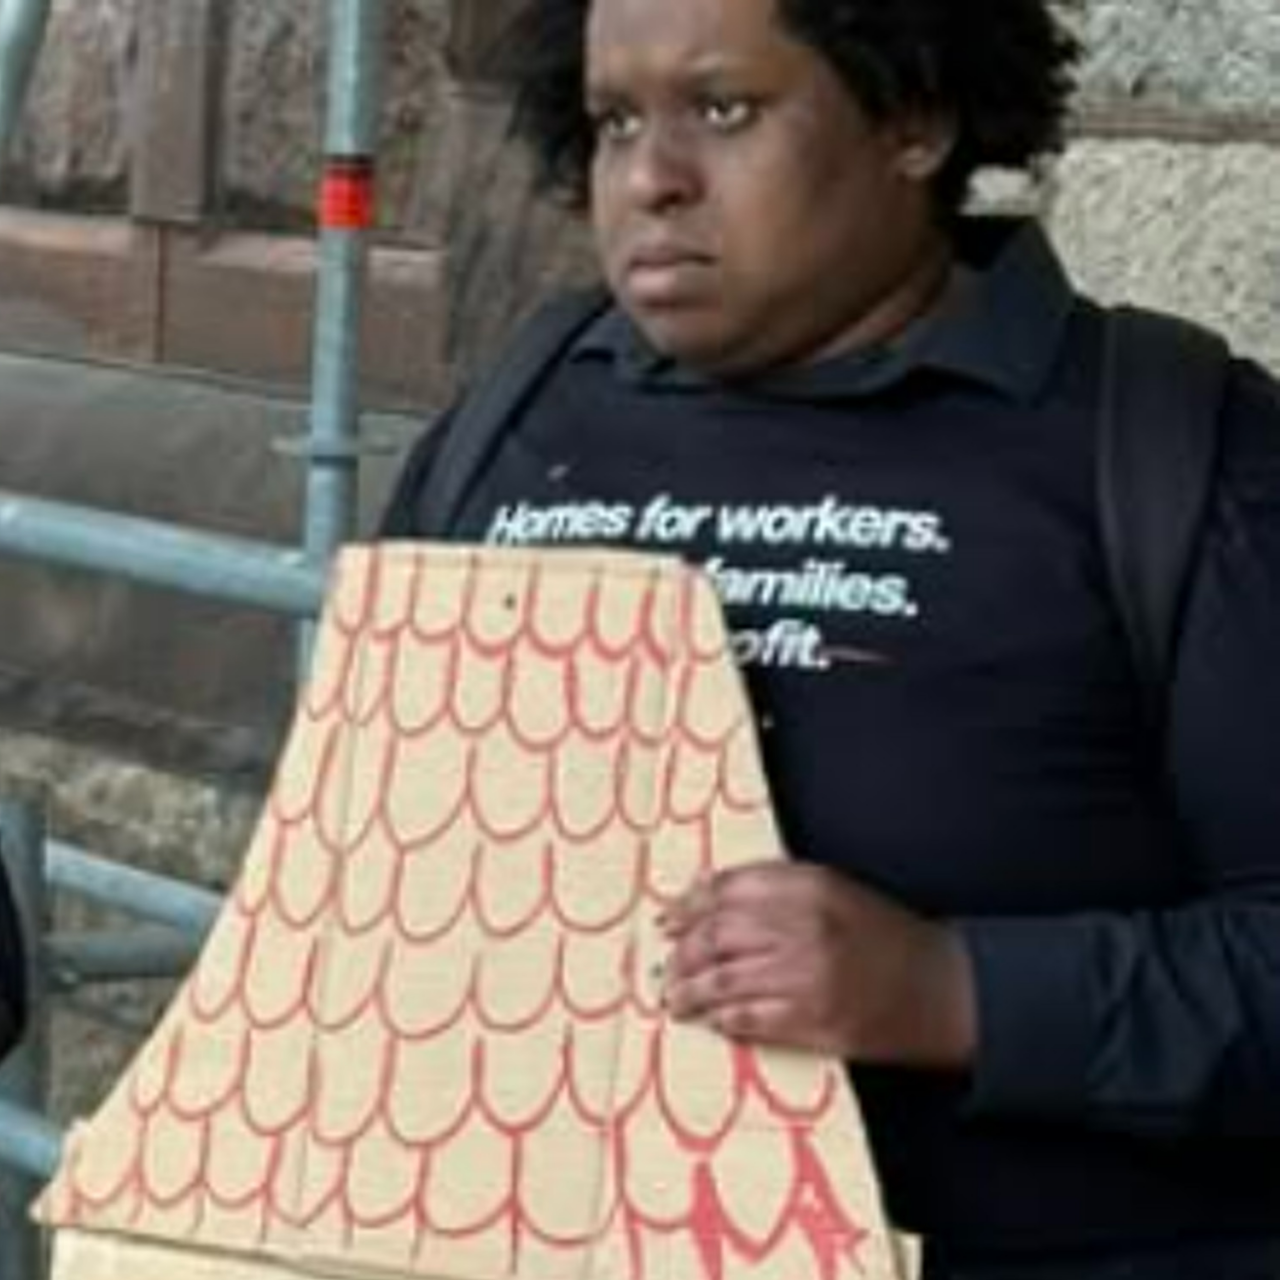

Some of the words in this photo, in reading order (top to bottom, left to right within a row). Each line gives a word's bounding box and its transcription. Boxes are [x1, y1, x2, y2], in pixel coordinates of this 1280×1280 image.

[486, 500, 630, 547] Homes
[635, 490, 713, 540] for
[716, 495, 950, 552] workers.
[728, 618, 832, 670] ofit.
